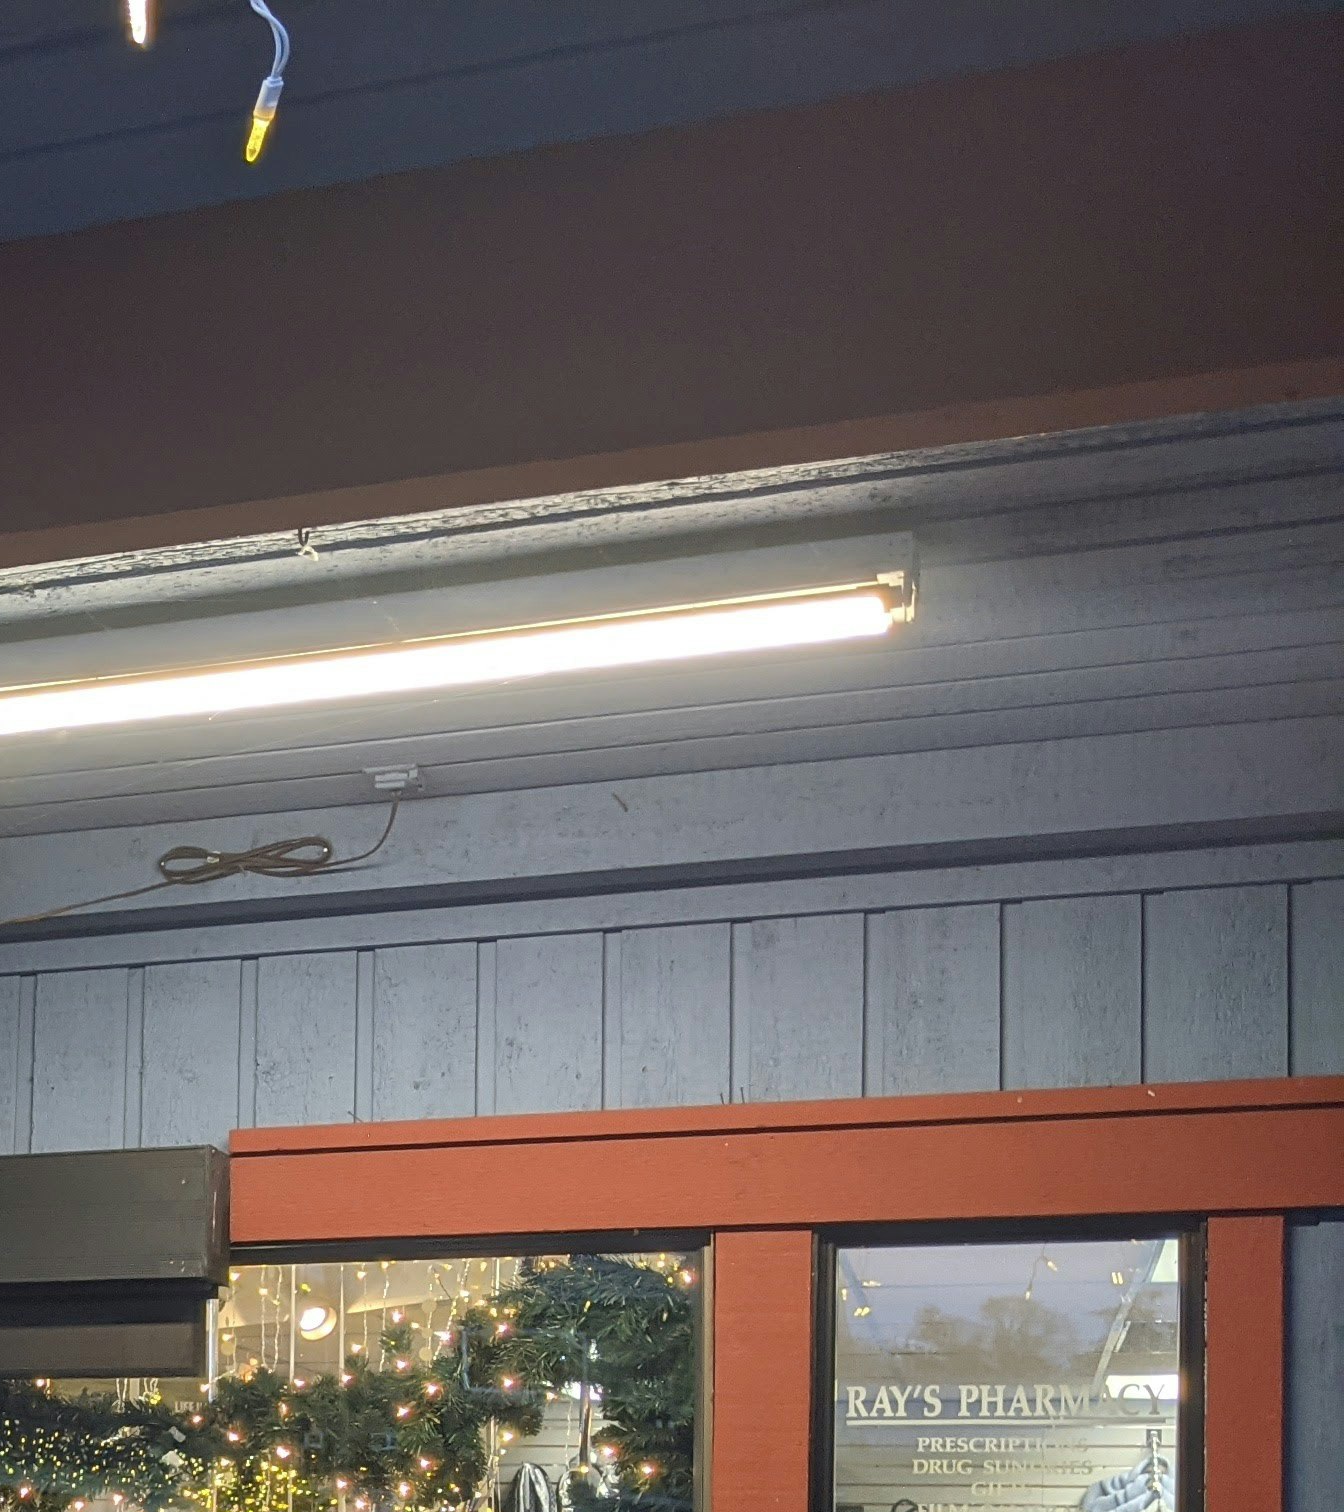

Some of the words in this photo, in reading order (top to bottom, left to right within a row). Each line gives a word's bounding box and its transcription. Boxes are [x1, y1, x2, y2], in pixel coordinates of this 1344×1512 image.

[846, 1384, 942, 1418] RAY'S
[958, 1383, 1166, 1417] PHARMACY
[912, 1460, 973, 1475] DRUG
